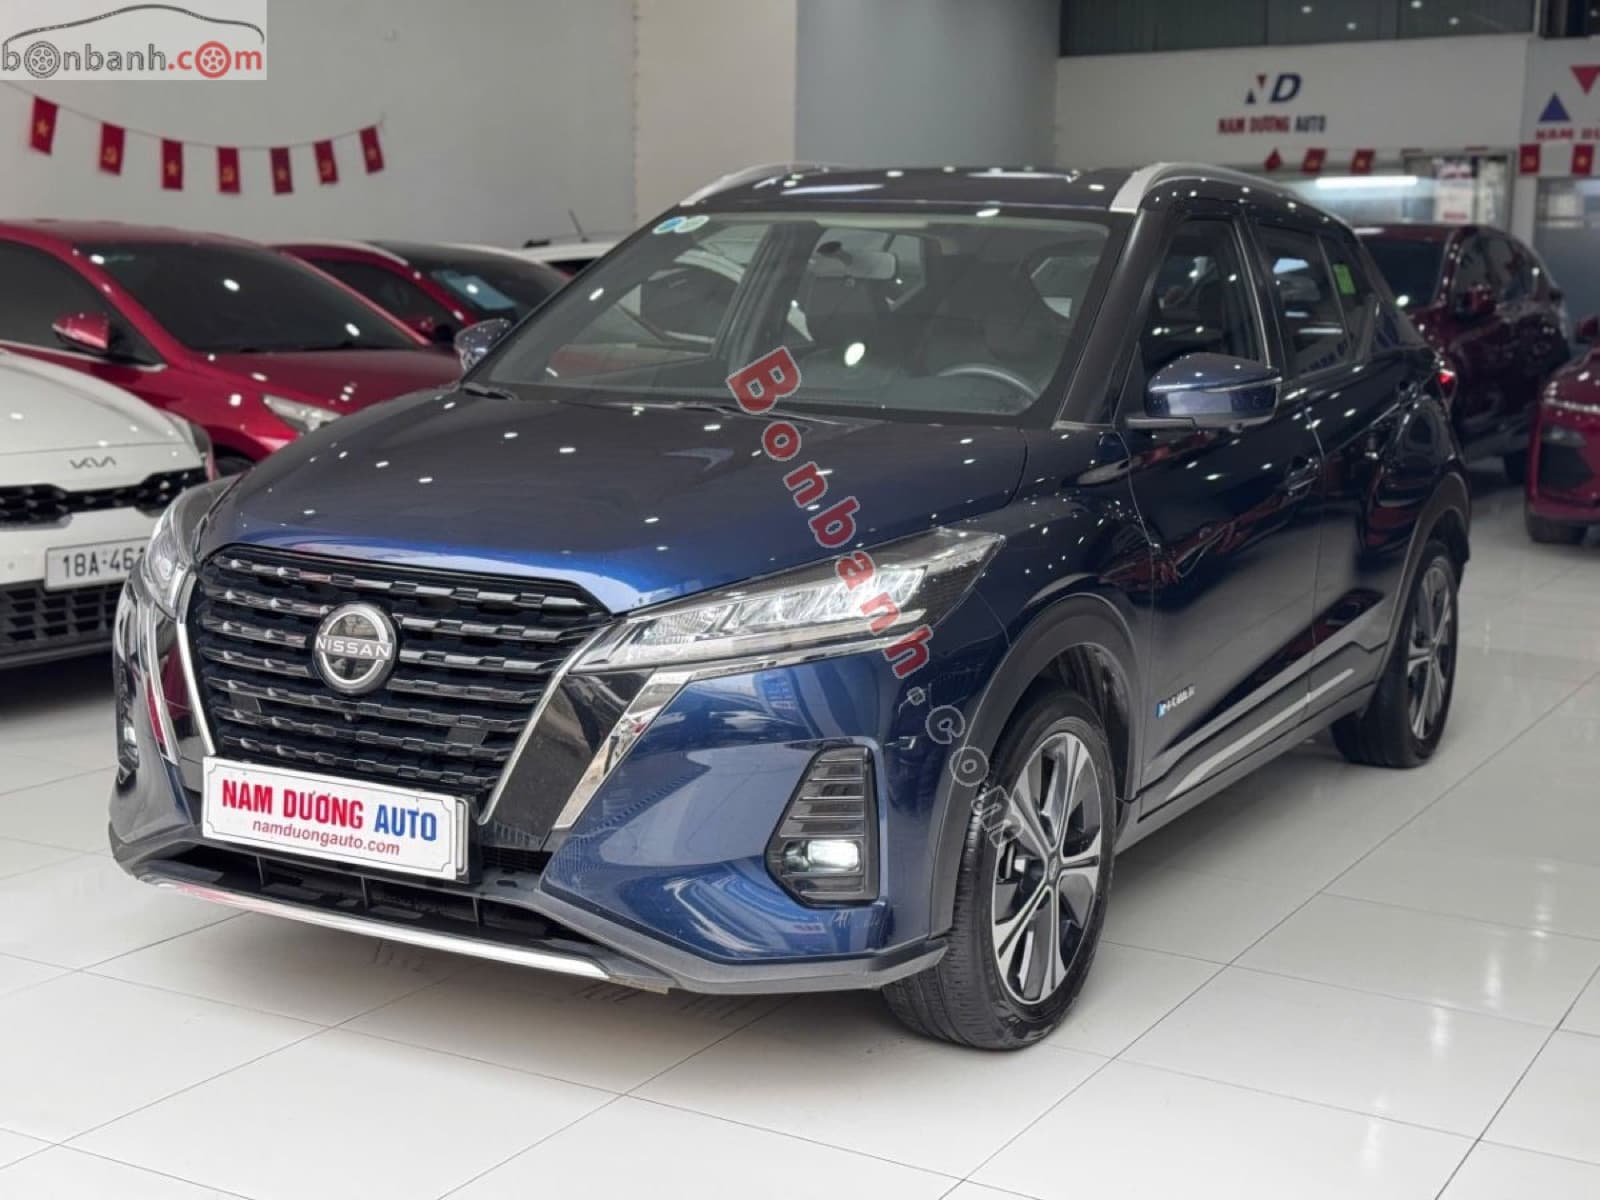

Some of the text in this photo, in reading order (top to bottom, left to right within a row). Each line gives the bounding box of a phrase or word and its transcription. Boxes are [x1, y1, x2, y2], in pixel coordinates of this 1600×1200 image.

[315, 636, 391, 657] NISSAN
[222, 779, 273, 815] NAM
[374, 804, 437, 842] AUTO
[252, 818, 400, 856] namduongauto.com
